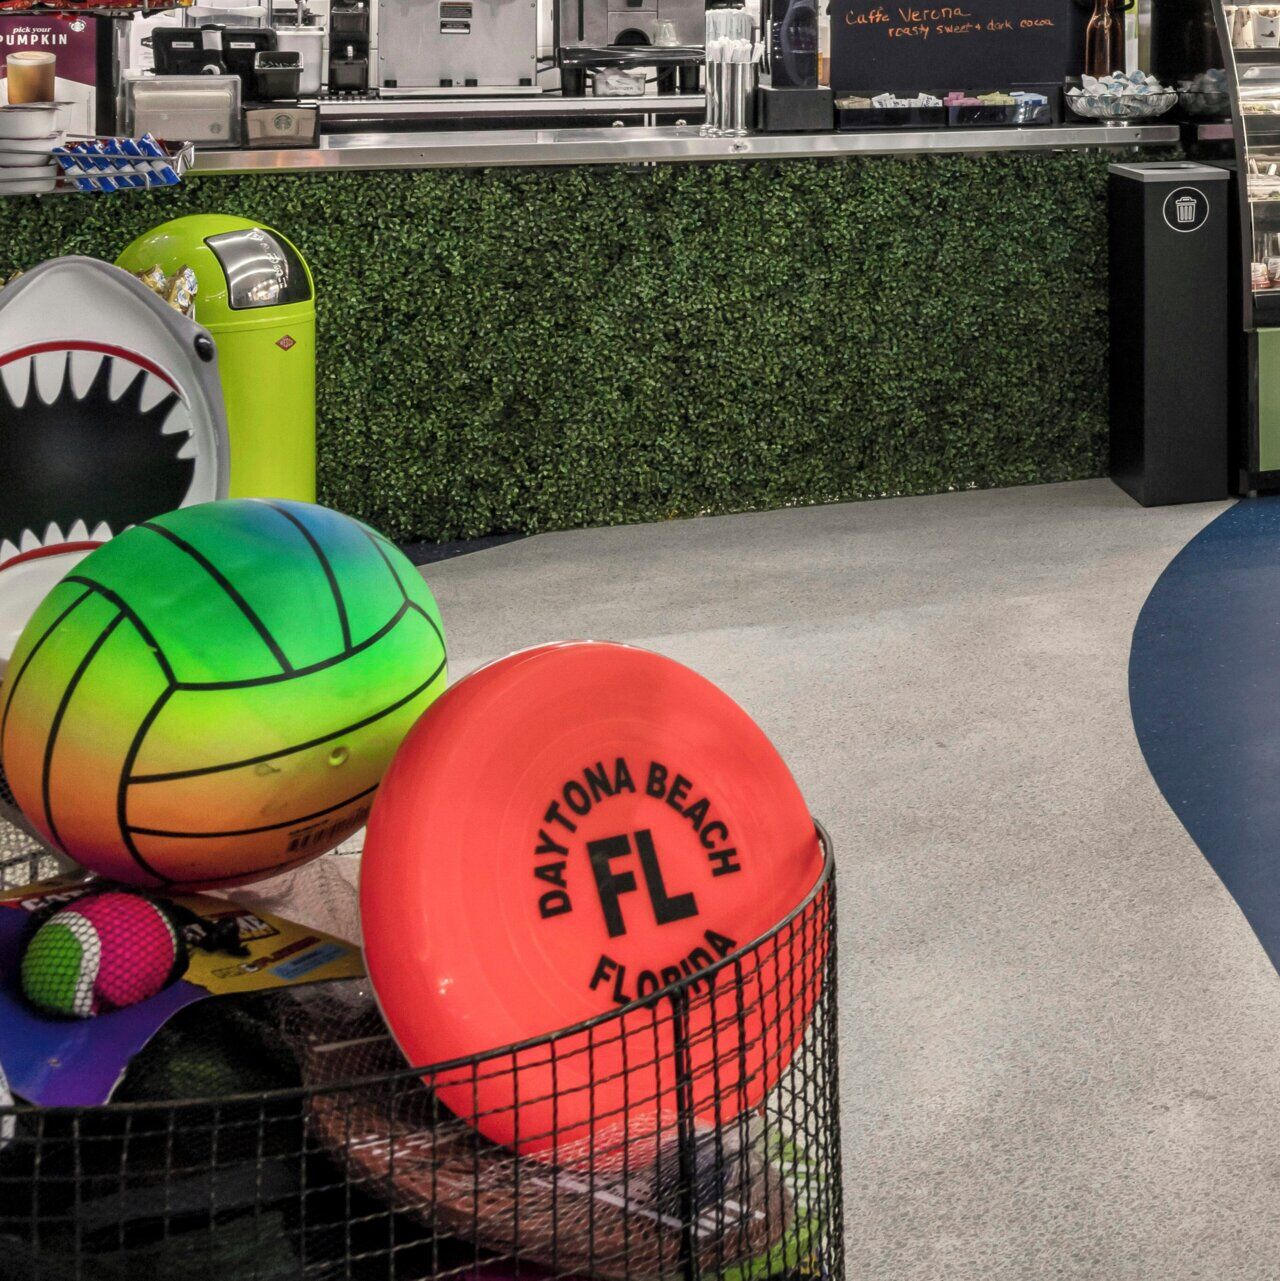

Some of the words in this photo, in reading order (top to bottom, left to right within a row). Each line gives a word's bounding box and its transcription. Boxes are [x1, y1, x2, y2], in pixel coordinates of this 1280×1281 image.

[12, 26, 31, 34] pick
[888, 22, 930, 40] roasty
[987, 18, 1013, 31] dark
[899, 7, 971, 23] Verona
[534, 757, 638, 920] DAYTONA
[645, 760, 742, 878] BEACH
[586, 828, 699, 940] FL
[588, 929, 738, 1010] FLORIDA
